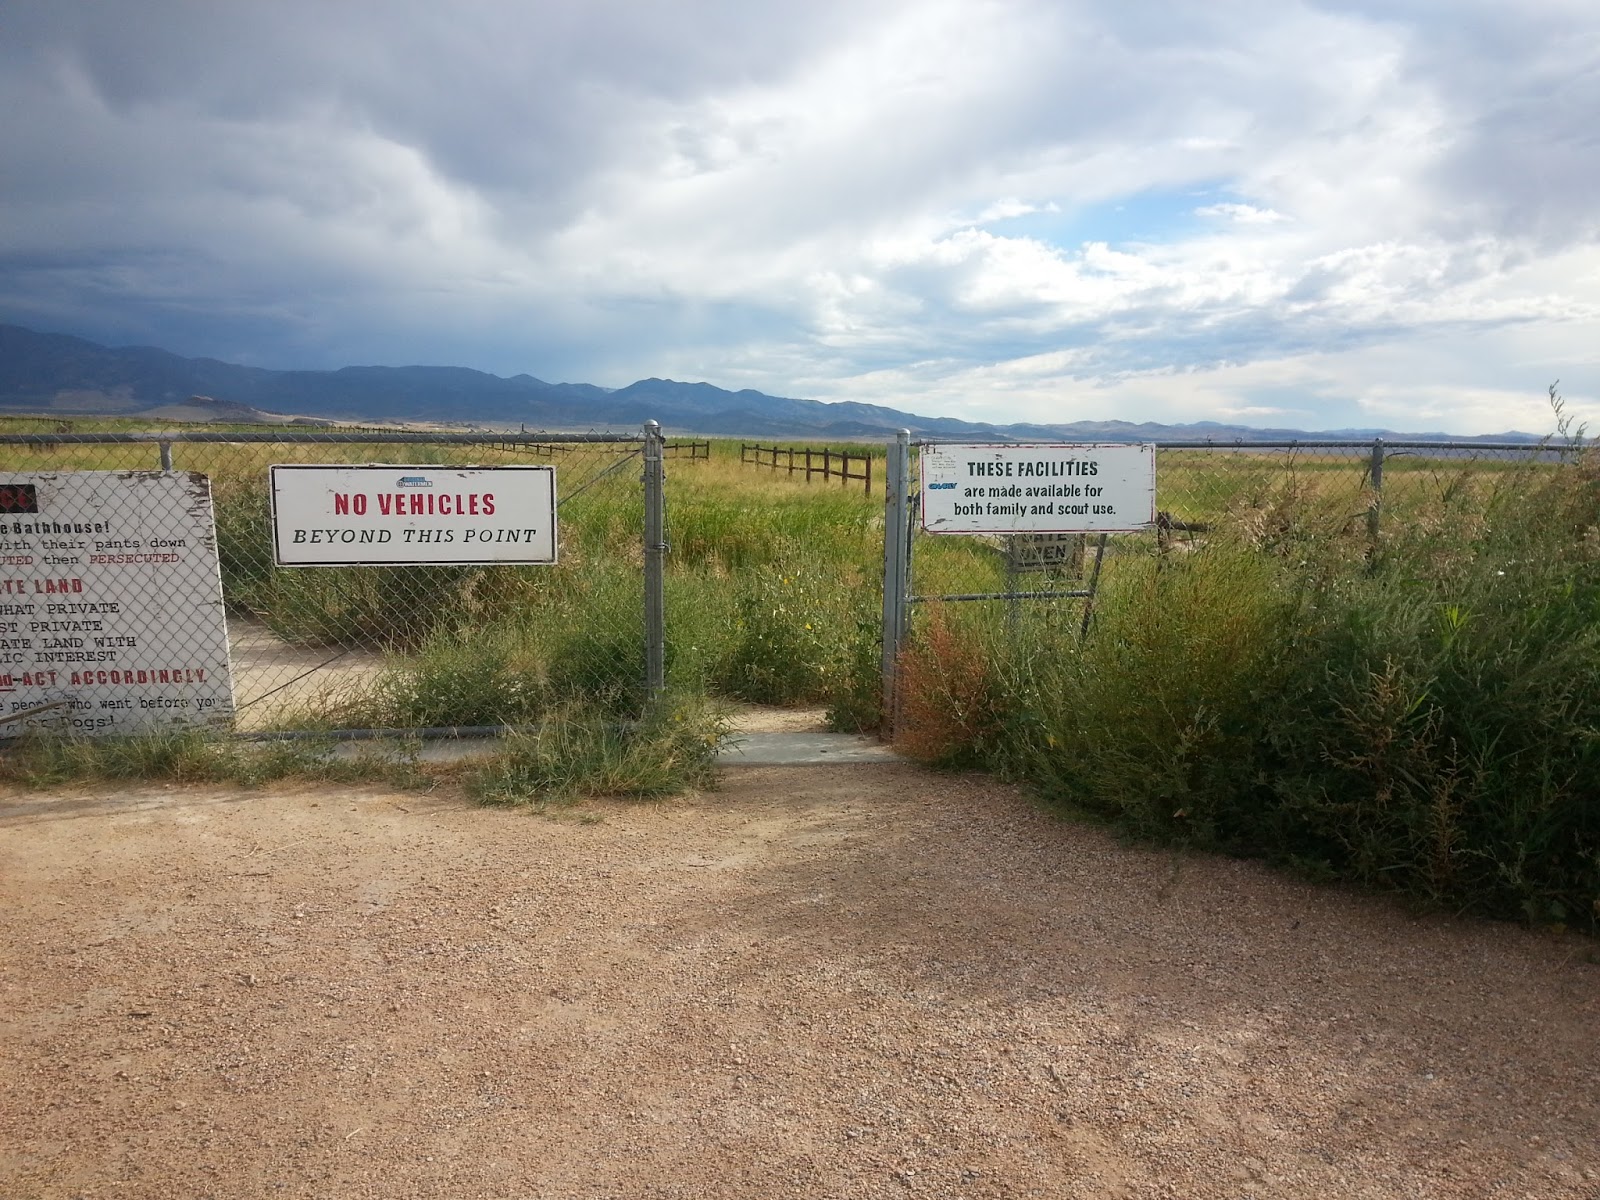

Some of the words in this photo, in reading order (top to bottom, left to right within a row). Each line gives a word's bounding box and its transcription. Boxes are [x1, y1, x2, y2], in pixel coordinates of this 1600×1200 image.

[967, 462, 1013, 477] THESE
[1018, 461, 1098, 477] FACILITIES
[964, 487, 985, 498] are
[988, 484, 1022, 498] made
[1025, 484, 1081, 498] available
[1084, 484, 1103, 497] for
[335, 493, 367, 516] NO
[377, 493, 495, 516] VEHICLES
[954, 502, 983, 516] both
[986, 502, 1027, 518] family
[1030, 501, 1053, 515] and
[1058, 503, 1089, 516] scout
[1092, 505, 1117, 516] use.
[13, 521, 110, 535] Bathhouse!
[293, 529, 392, 544] BEYOND
[403, 529, 454, 543] THIS
[463, 528, 537, 543] POINT
[41, 539, 86, 550] their
[95, 539, 140, 552] pants
[150, 537, 187, 549] down
[43, 554, 79, 565] then
[0, 580, 26, 595] TE
[34, 578, 83, 594] LAND
[46, 602, 120, 615] PRIVATE
[30, 620, 103, 632] PRIVATE
[42, 637, 84, 649] LAND
[93, 636, 137, 648] WITH
[34, 650, 117, 663] INTEREST
[71, 668, 207, 686] ACCORDINGLY.
[67, 697, 92, 710] who
[100, 698, 133, 710] went
[139, 696, 189, 709] before
